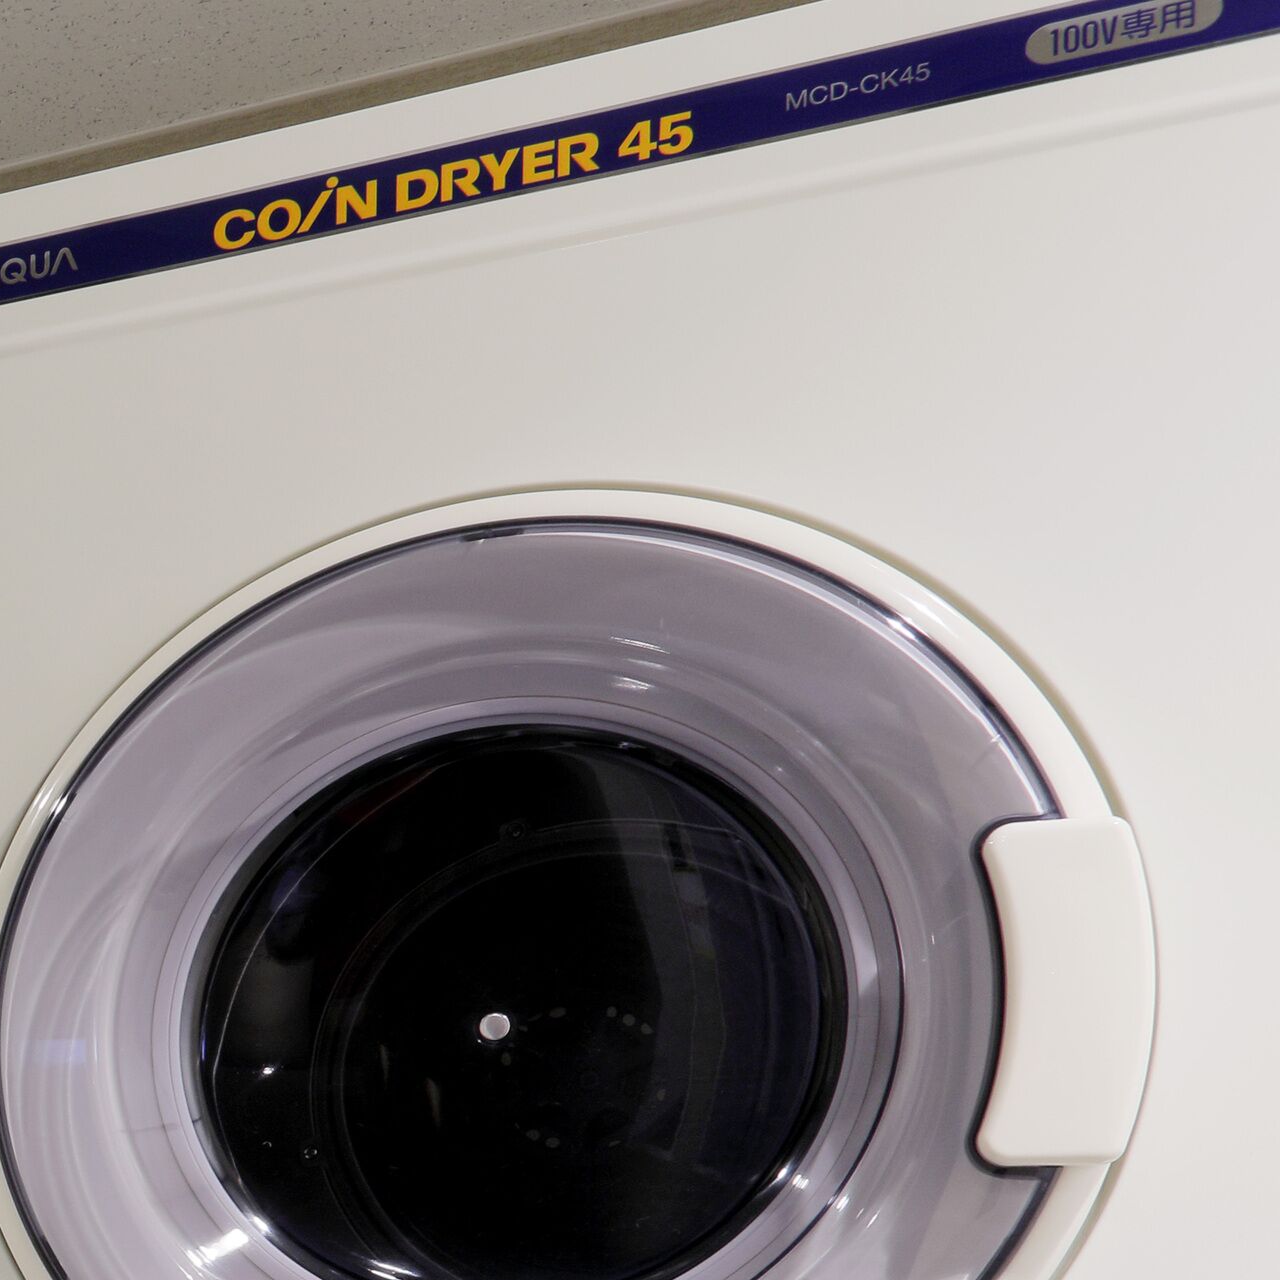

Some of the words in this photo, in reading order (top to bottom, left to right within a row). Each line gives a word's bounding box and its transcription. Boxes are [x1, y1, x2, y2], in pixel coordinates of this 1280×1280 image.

[1049, 0, 1195, 57] 100V専用
[785, 62, 931, 112] MCD-CK45
[395, 132, 600, 214] DRYER
[618, 111, 694, 162] 45
